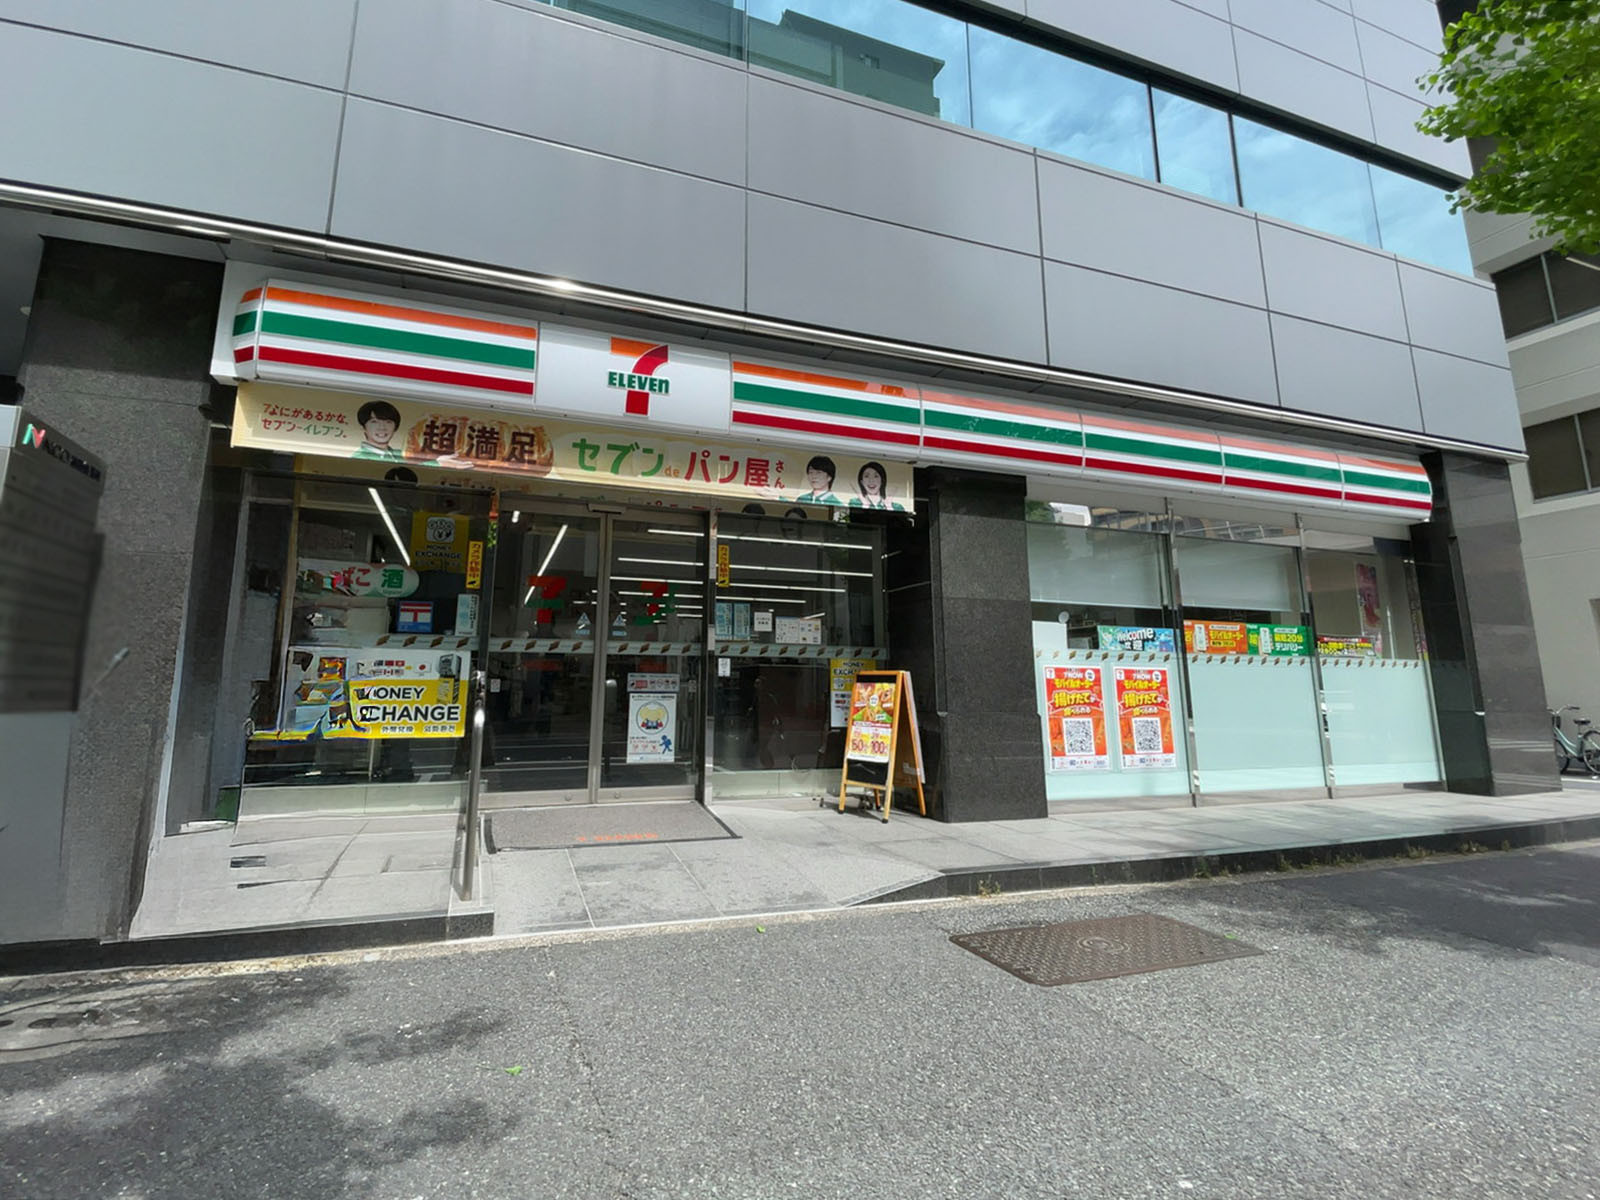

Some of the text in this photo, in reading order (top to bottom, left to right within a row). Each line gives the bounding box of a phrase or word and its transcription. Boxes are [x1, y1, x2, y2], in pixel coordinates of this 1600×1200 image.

[422, 419, 536, 465] 超満足
[381, 568, 404, 589] 酒
